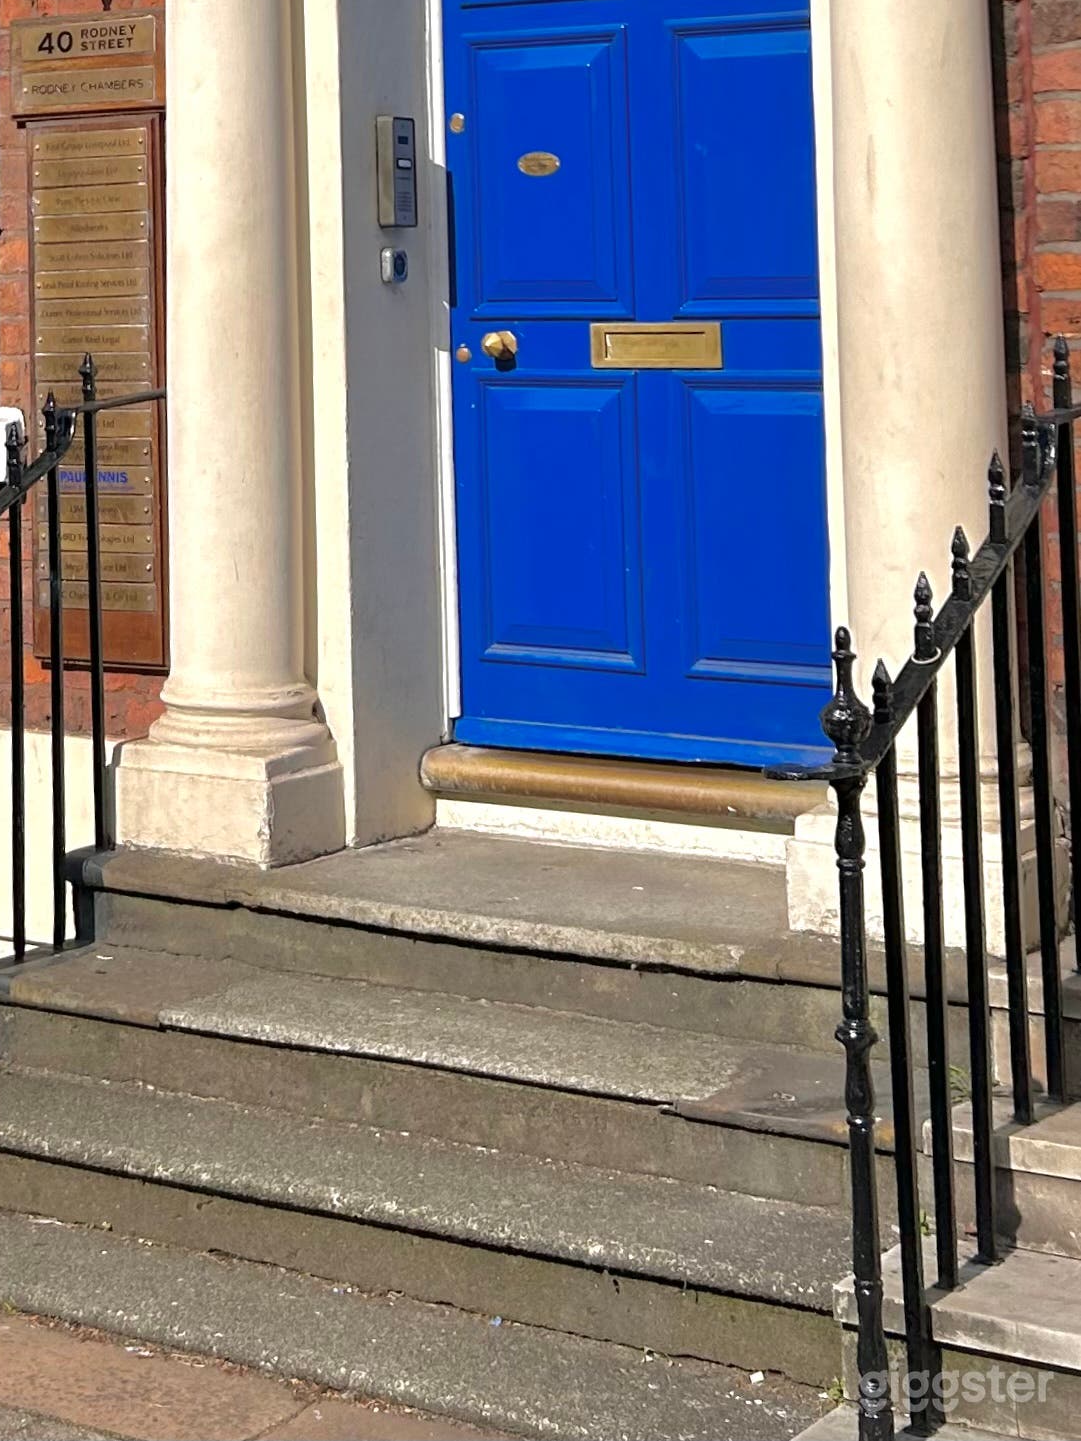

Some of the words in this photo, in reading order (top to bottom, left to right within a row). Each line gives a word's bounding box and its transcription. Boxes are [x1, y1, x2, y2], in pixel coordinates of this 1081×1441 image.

[80, 24, 137, 39] RODNEY
[37, 31, 73, 54] 40
[80, 37, 134, 51] STREET
[31, 83, 76, 95] RODNEY
[80, 78, 144, 93] CHAMBERS
[98, 471, 129, 484] NNIS
